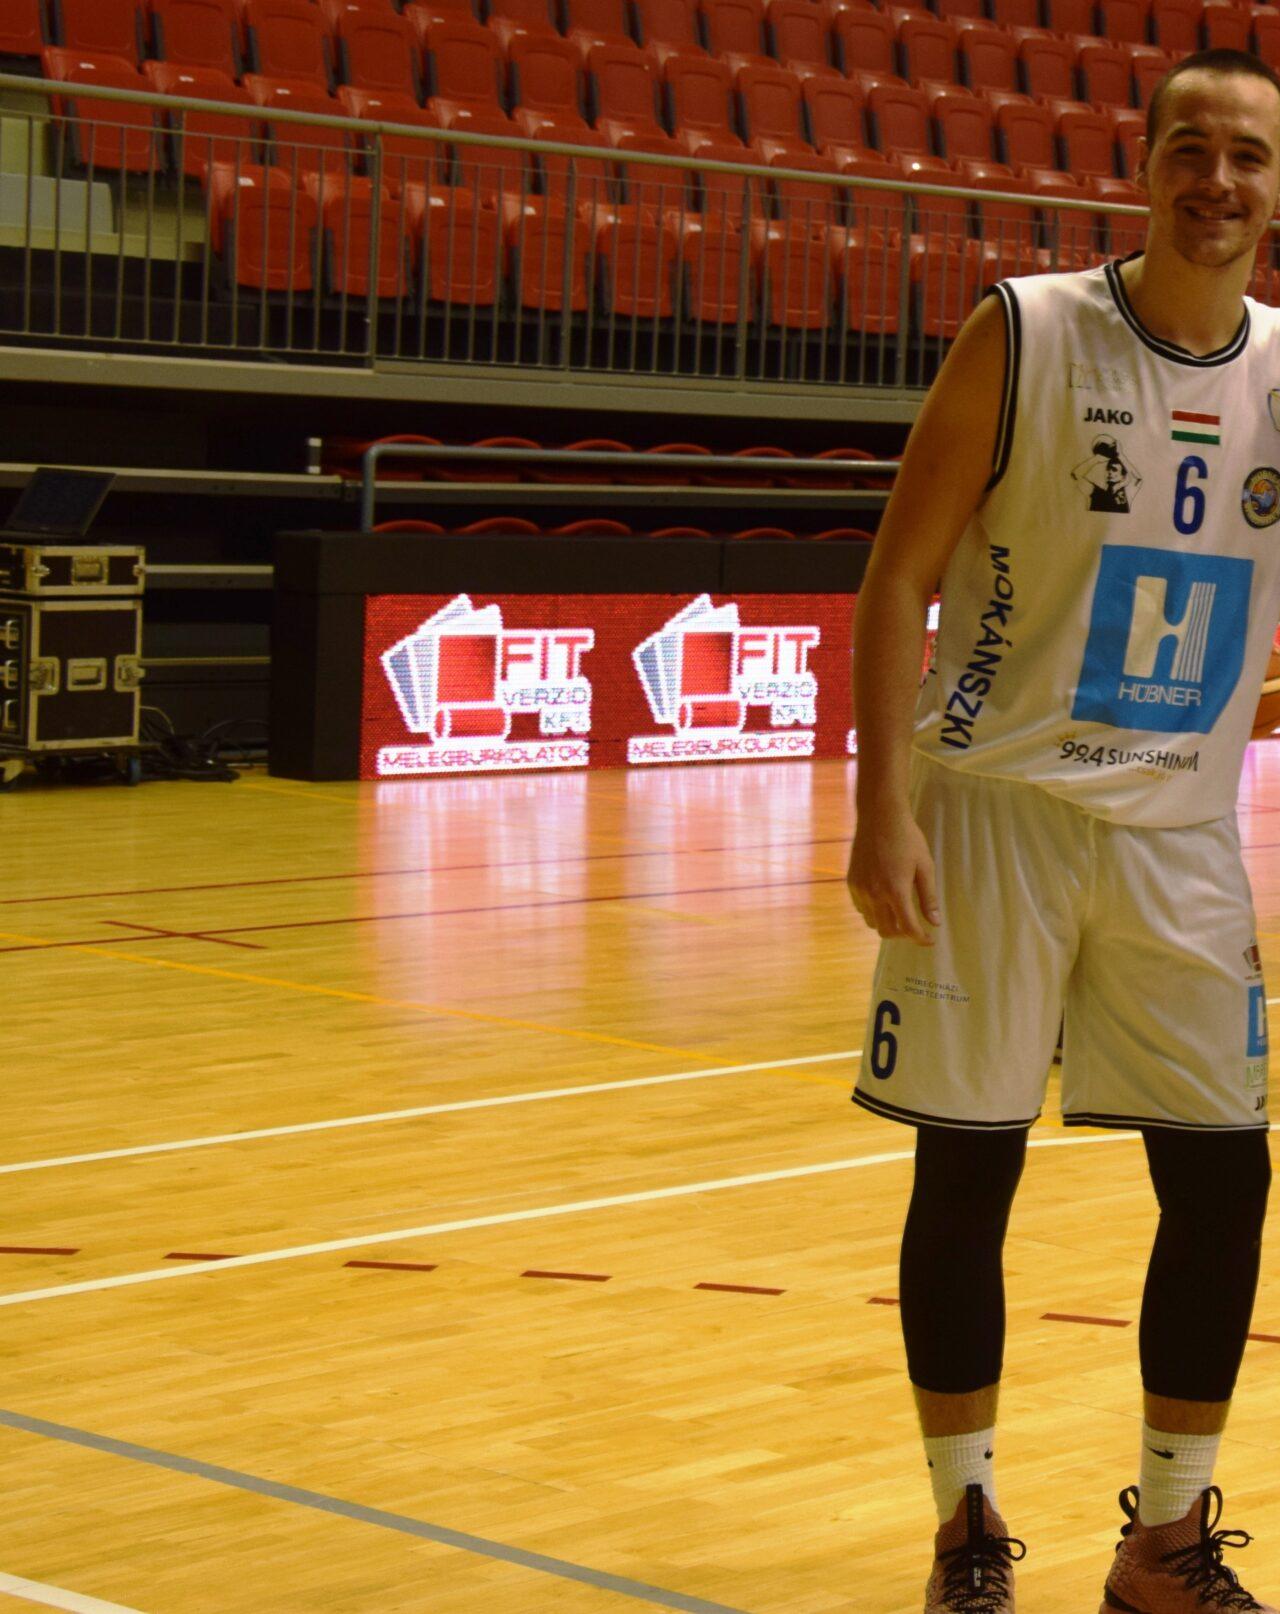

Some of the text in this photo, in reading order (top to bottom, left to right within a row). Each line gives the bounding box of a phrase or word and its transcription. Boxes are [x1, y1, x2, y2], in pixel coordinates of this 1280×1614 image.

[1083, 407, 1134, 426] JAKO
[1173, 456, 1208, 536] 6
[500, 635, 589, 681] FIT
[737, 632, 816, 675] FIT
[939, 544, 1015, 751] MOKÁNSZKI
[1118, 682, 1203, 707] HÜBNER
[1059, 741, 1104, 767] 99.4
[870, 1000, 900, 1080] 6
